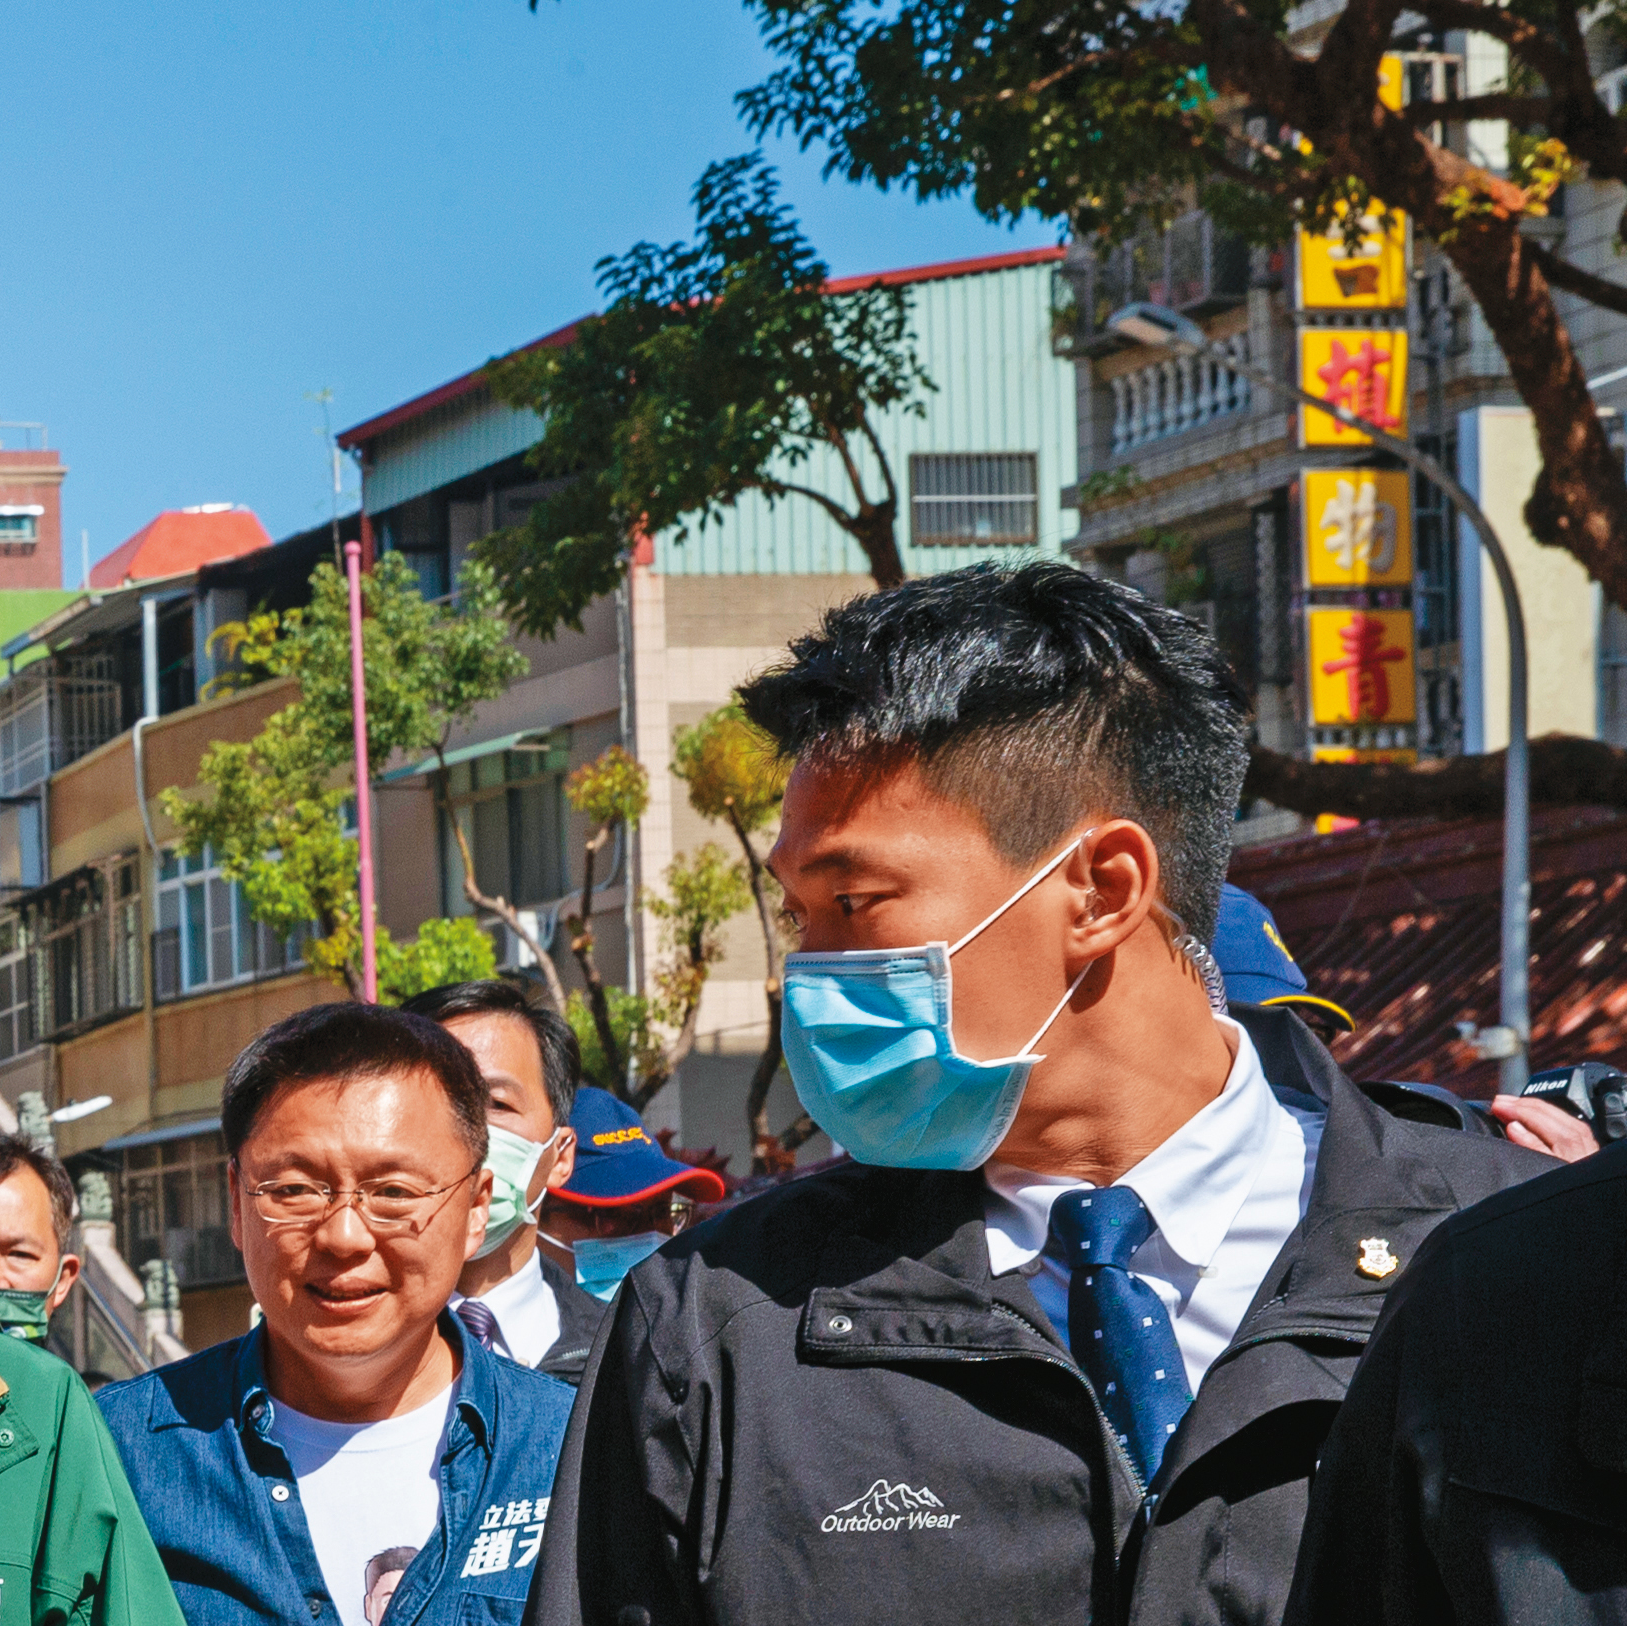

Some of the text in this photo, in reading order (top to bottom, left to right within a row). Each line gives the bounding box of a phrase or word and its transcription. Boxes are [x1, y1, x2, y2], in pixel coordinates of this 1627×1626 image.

[1523, 1079, 1569, 1095] Nikon
[821, 1511, 961, 1532] Outdoor Wear
